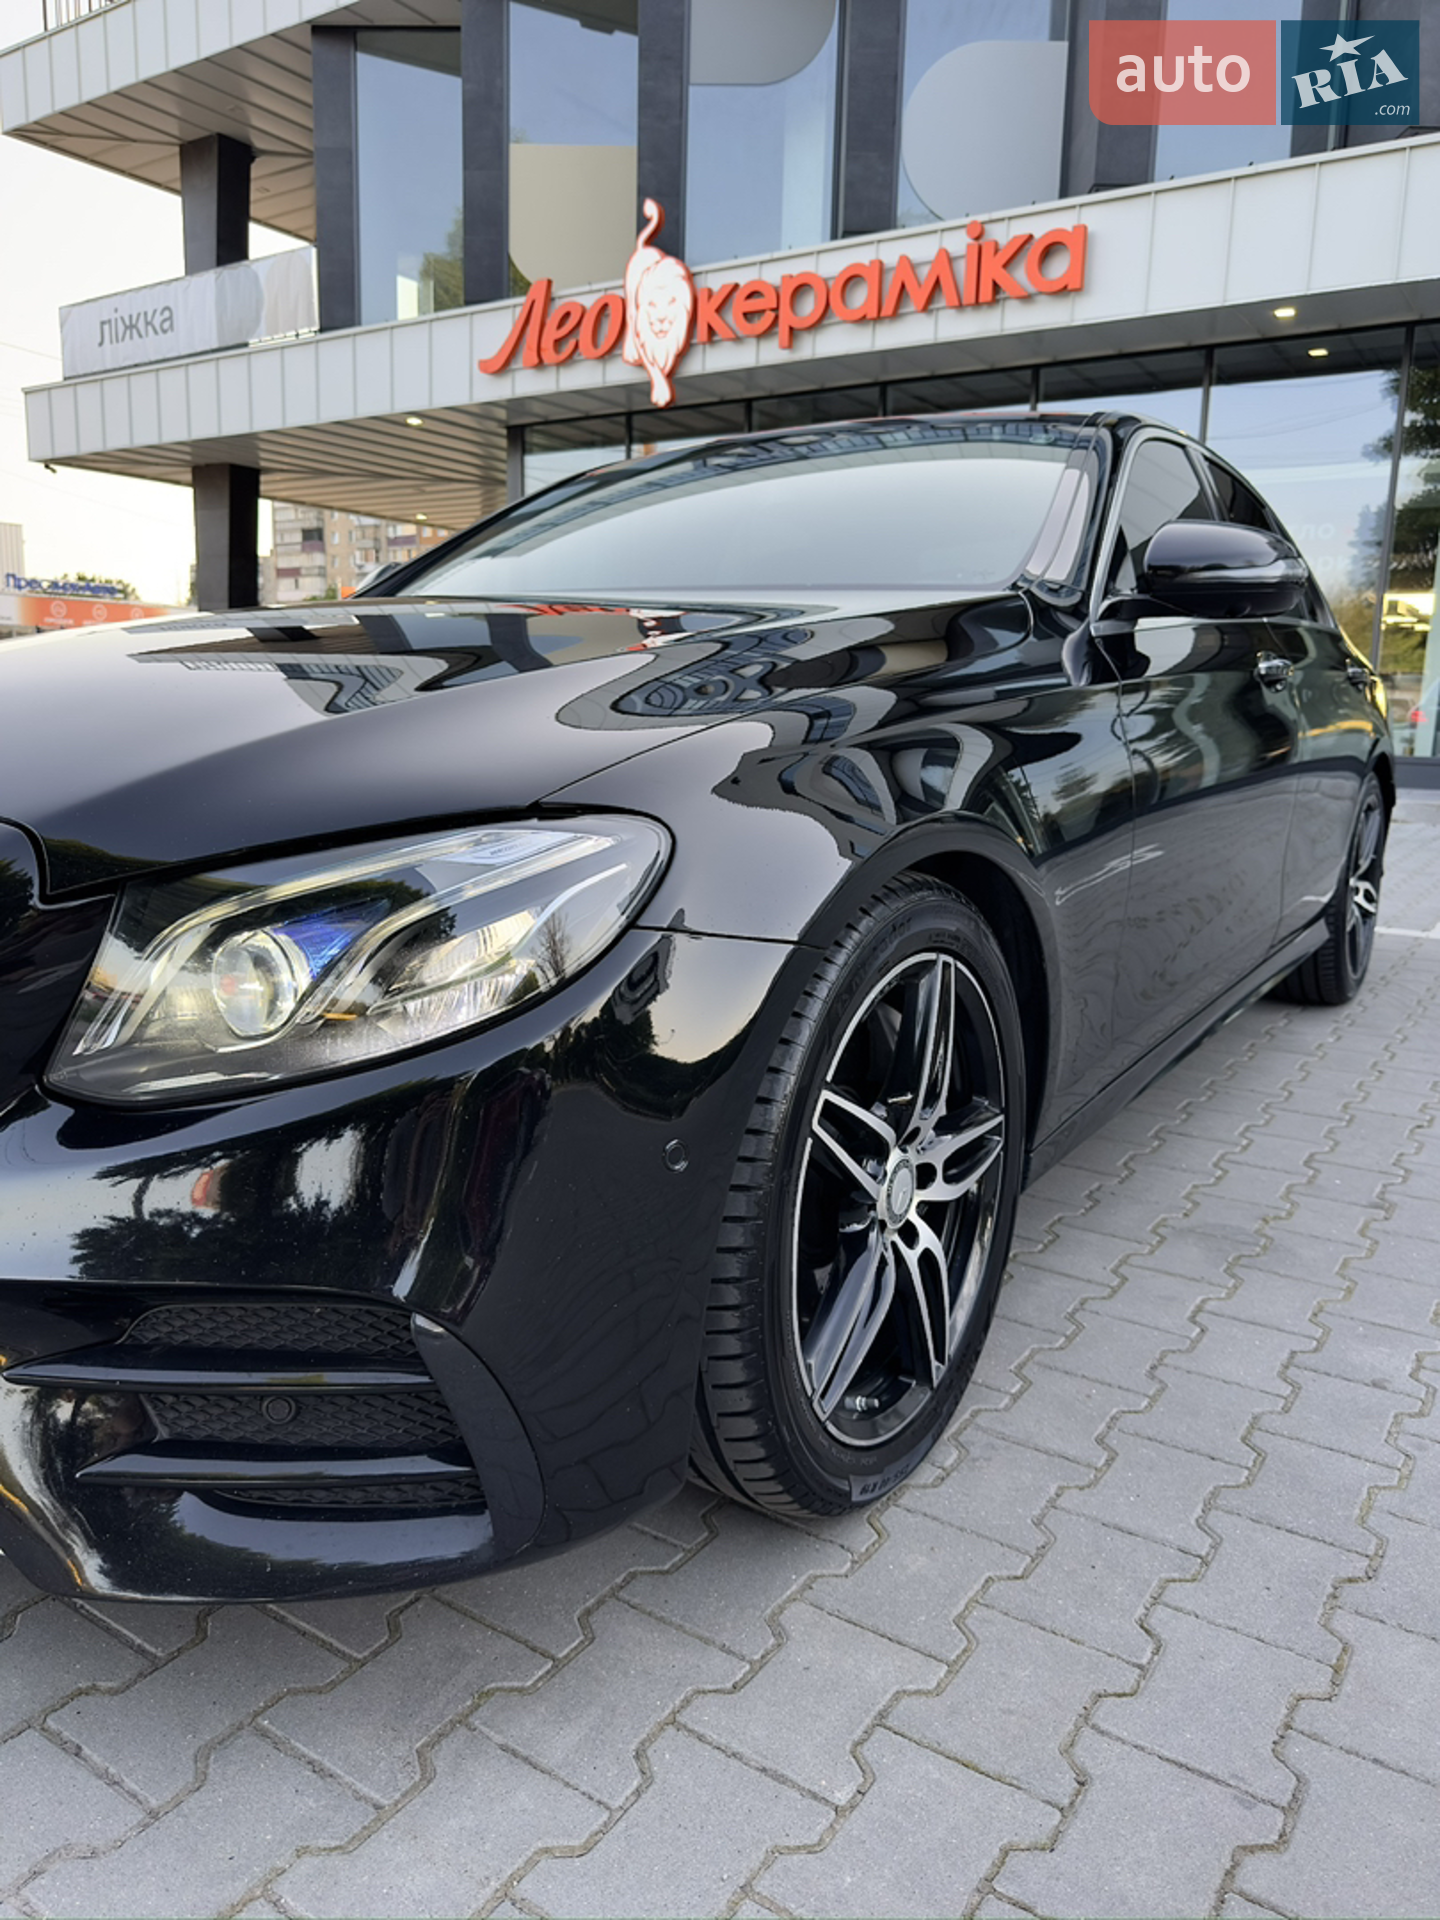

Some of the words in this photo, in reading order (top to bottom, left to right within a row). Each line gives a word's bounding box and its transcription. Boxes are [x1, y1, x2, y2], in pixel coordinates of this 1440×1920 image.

[98, 305, 175, 348] ліжка
[478, 278, 626, 375] Лео
[696, 220, 1088, 349] кераміка
